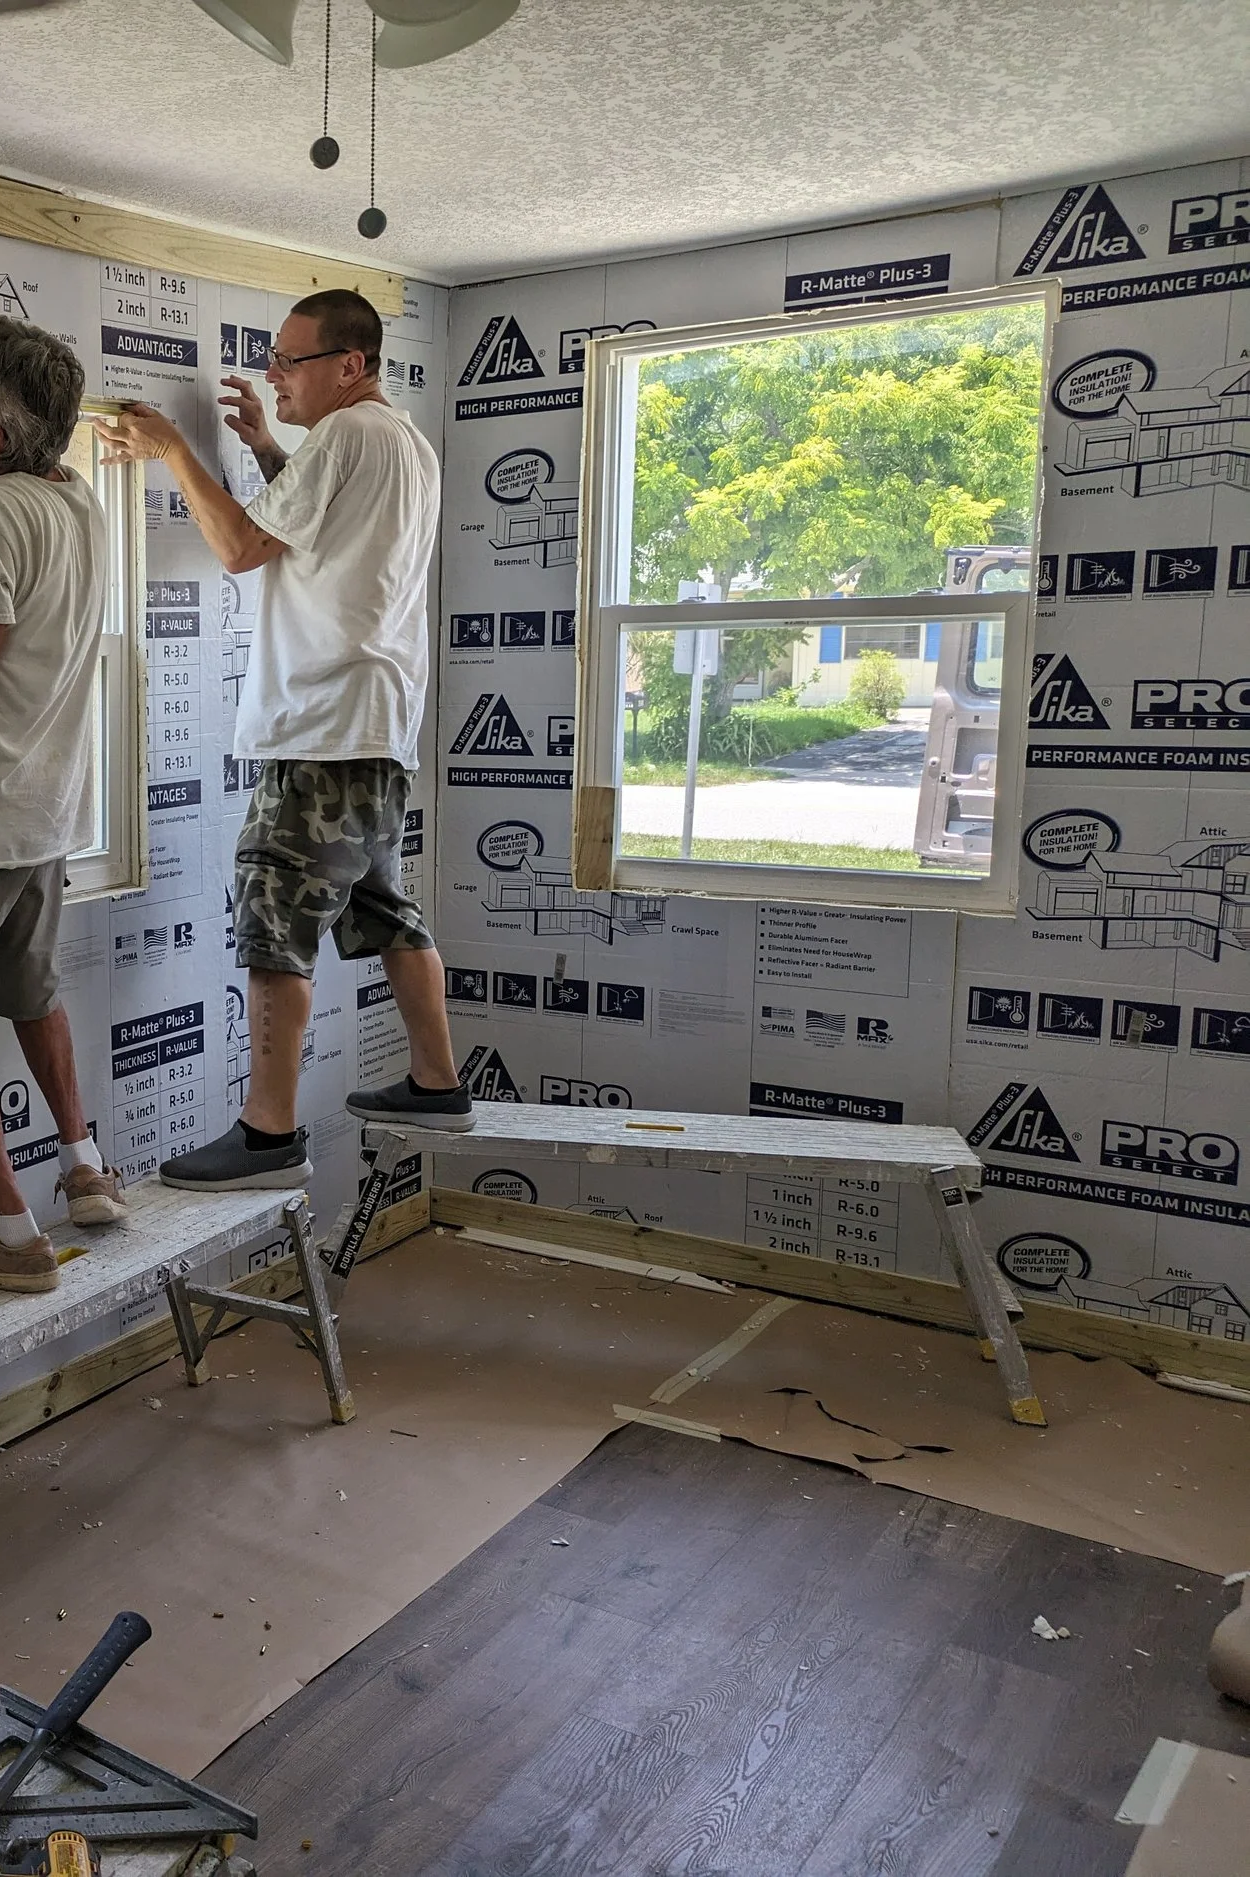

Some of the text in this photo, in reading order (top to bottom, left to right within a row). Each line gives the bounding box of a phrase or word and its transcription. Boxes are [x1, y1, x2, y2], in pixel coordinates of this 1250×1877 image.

[1057, 211, 1130, 264] Sika
[879, 263, 932, 284] Plus-3
[22, 281, 39, 294] Roof
[160, 276, 186, 295] R-9.6
[1062, 275, 1197, 307] PERFORMANCE
[160, 307, 189, 326] R-13.1
[117, 335, 184, 360] ADVANTAGES
[485, 337, 534, 379] Sika
[1070, 361, 1133, 387] COMPLETE
[1069, 372, 1132, 397] INSULATION!
[459, 392, 579, 416] HIGH PERFORMANCE
[497, 459, 540, 478] COMPLETE
[497, 468, 539, 485] INSULATION!
[1060, 485, 1115, 497] Basement
[460, 523, 485, 533] Garage
[161, 588, 191, 603] Plus-3
[160, 619, 193, 632] R-VALUE
[163, 645, 189, 658] R-3.2
[1029, 680, 1094, 722] Sika
[476, 715, 523, 750] Sika
[1032, 750, 1213, 766] PERFORMANCE FOAM
[451, 771, 566, 785] HIGH PERFORMANCE
[488, 831, 529, 845] COMPLETE
[1039, 822, 1100, 838] COMPLETE
[1199, 826, 1228, 838] Attic
[453, 883, 478, 893] Garage
[486, 920, 522, 931] Basement
[1032, 930, 1083, 943] Basement
[166, 1009, 195, 1030] Plus-3
[965, 1037, 1029, 1050] usa.sika.com/retail
[114, 1038, 198, 1073] THICKNESS R-VALUE
[541, 1077, 632, 1109] PRO
[837, 1099, 887, 1119] Plus-3
[1001, 1109, 1066, 1154] Sika
[1104, 1123, 1236, 1167] PRO
[395, 1160, 417, 1179] Plus-3
[1112, 1156, 1226, 1182] SELECT
[1005, 1172, 1180, 1211] PERFORMANCE FOAM
[838, 1199, 880, 1218] R-6.0
[339, 1182, 382, 1271] GORILLA LADDERS
[835, 1248, 880, 1268] R-13.1
[1013, 1247, 1071, 1258] COMPLETE
[1166, 1266, 1193, 1279] Attic
